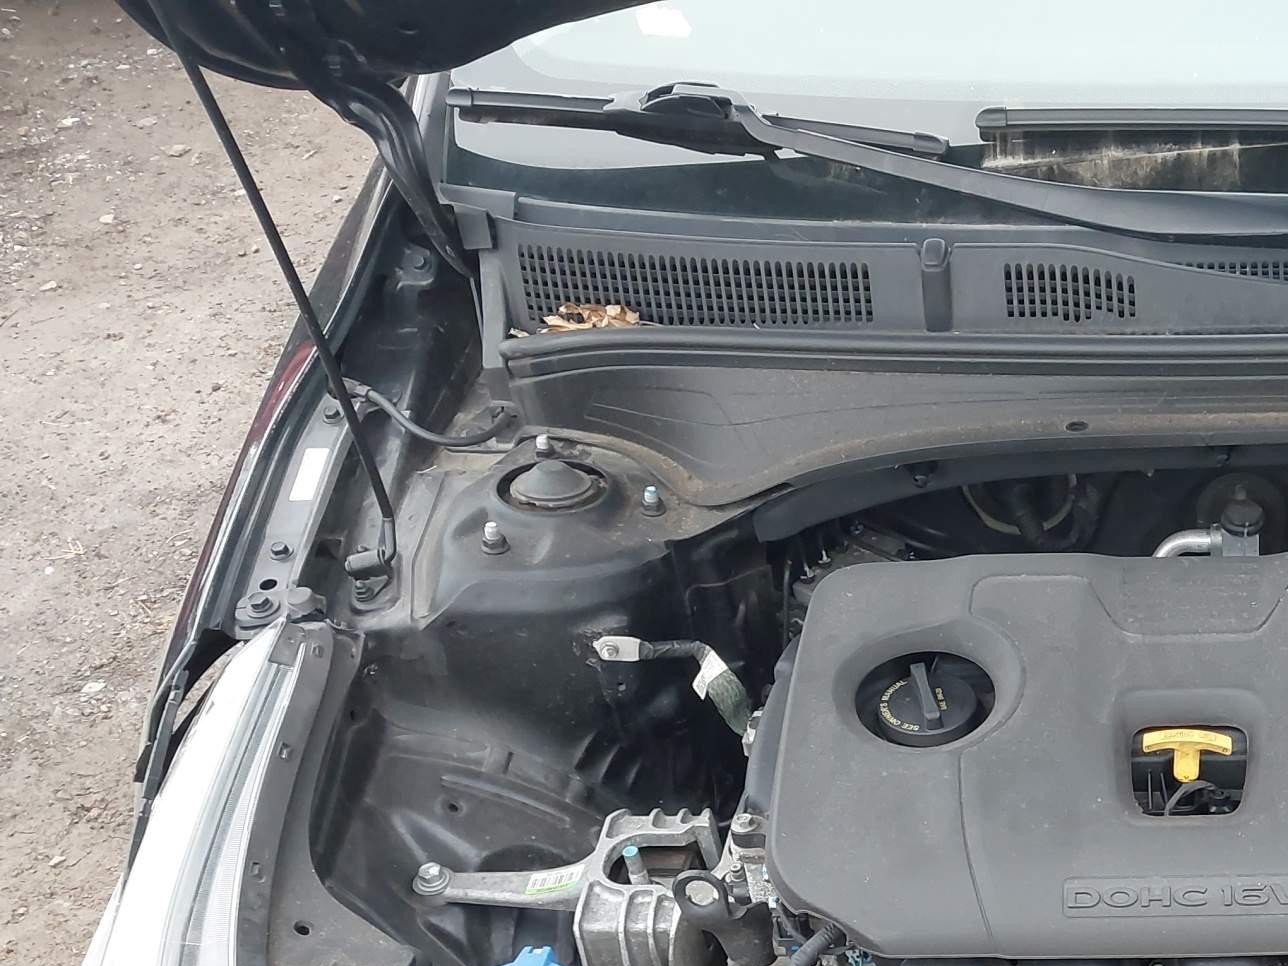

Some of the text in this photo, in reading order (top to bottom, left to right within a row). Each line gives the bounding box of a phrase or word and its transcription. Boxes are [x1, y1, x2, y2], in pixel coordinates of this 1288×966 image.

[881, 679, 908, 701] MANUAL
[900, 721, 920, 731] SEE
[1066, 885, 1209, 910] DOHC
